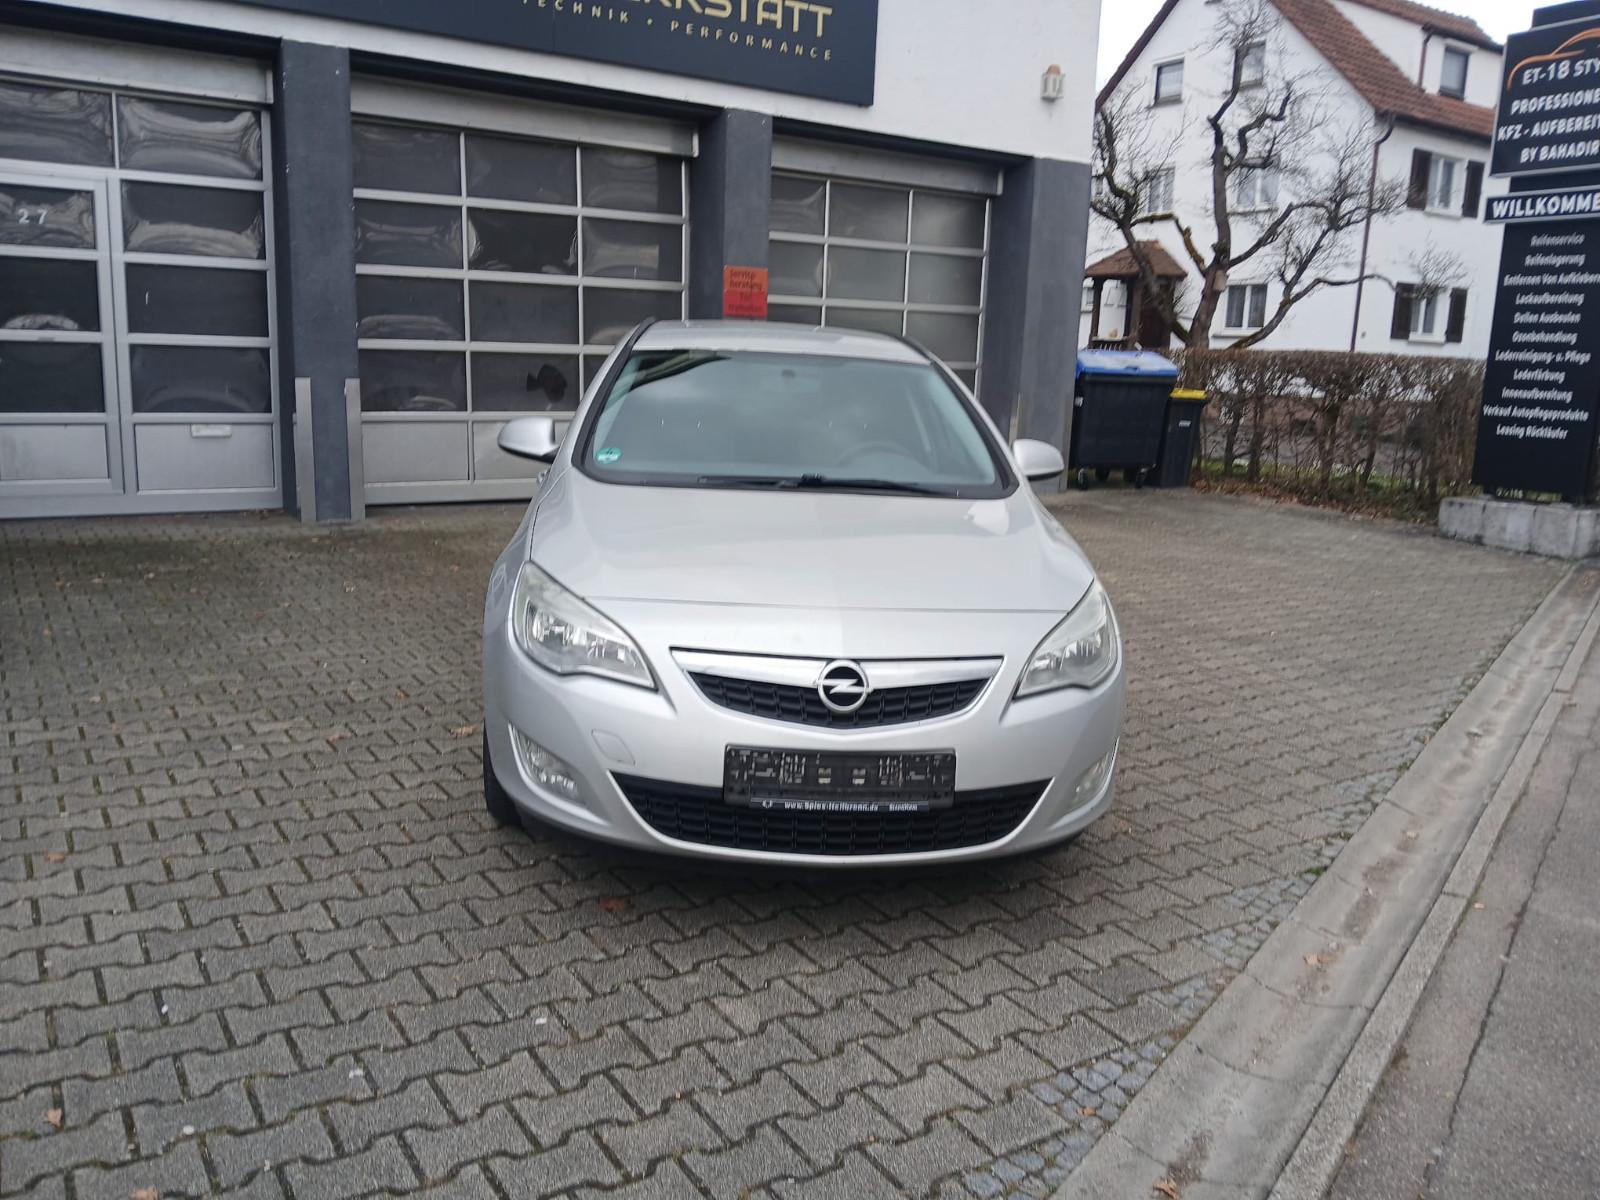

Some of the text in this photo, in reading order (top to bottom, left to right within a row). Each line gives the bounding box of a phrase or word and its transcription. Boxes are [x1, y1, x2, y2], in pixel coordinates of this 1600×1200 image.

[669, 19, 832, 62] PERFORMANCE
[1521, 59, 1571, 86] ET-18
[1510, 87, 1600, 116] PROFESSIONE
[1519, 139, 1600, 164] BY BAHADIR
[1492, 191, 1600, 219] WILLKOMME
[1515, 291, 1585, 307] Lackaufbereitung
[1482, 404, 1513, 418] Verkauf
